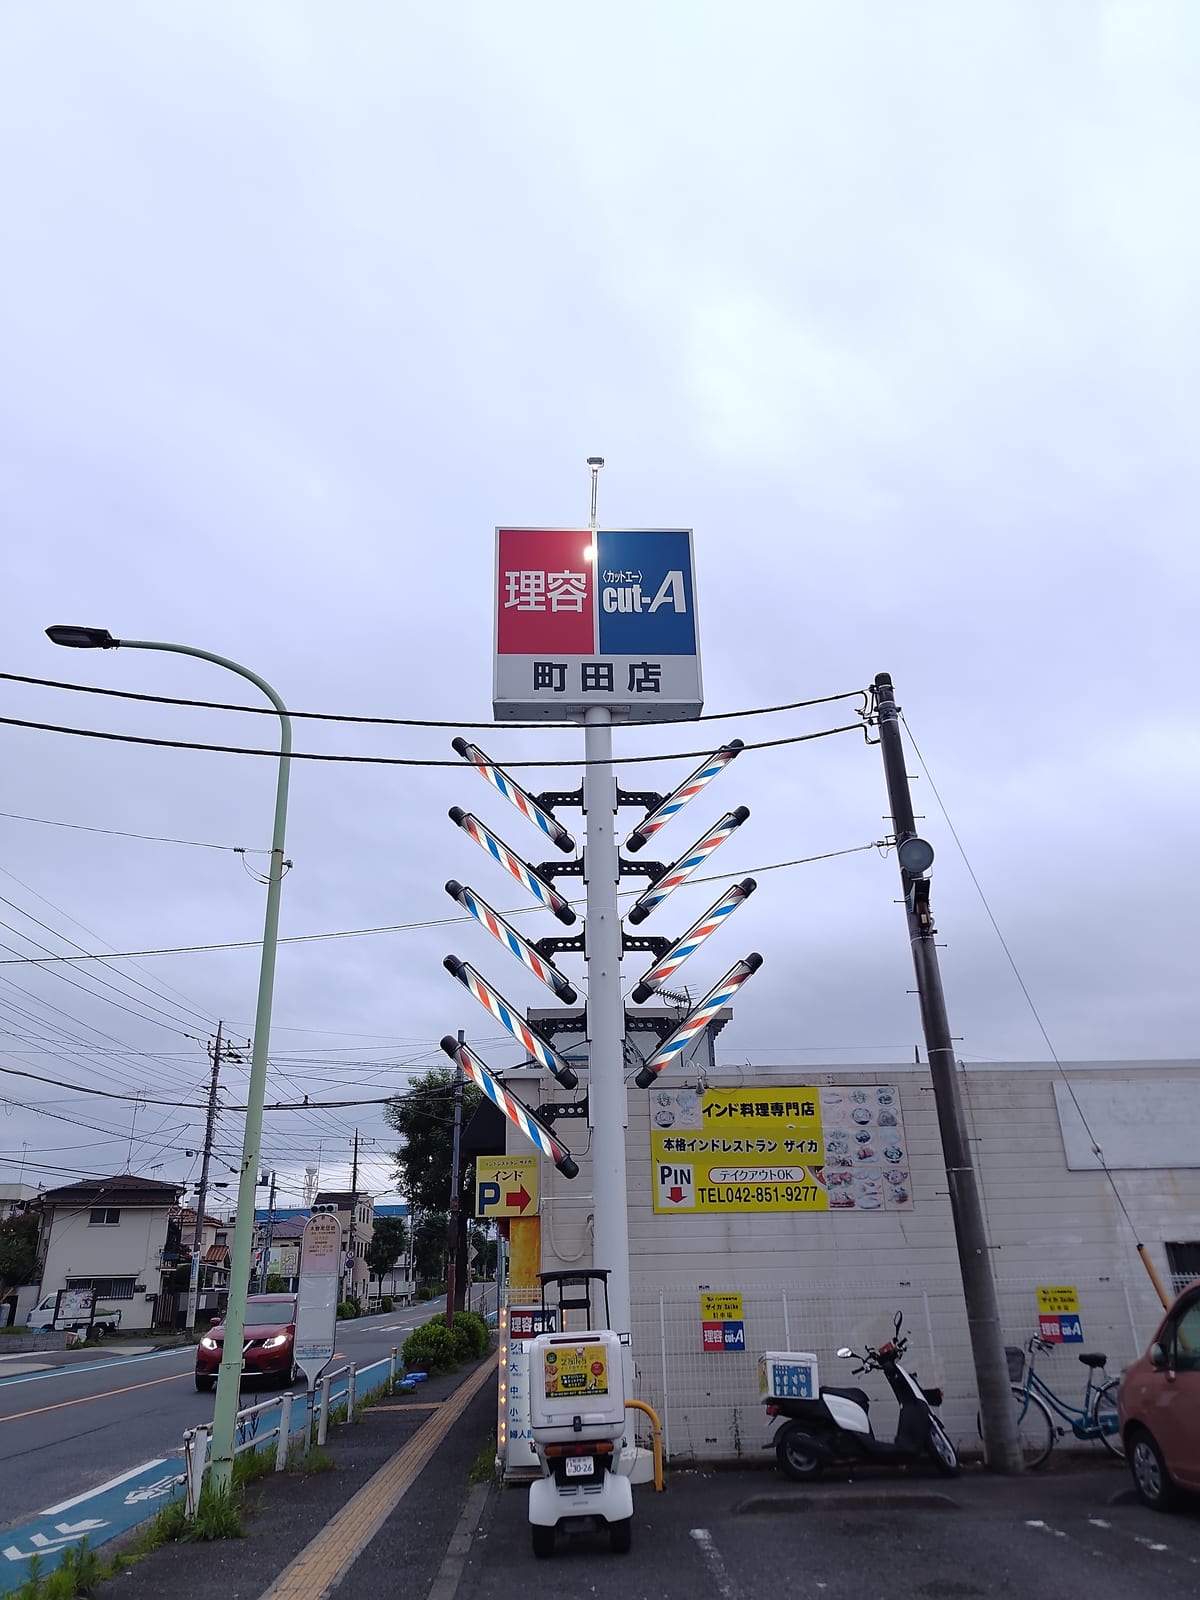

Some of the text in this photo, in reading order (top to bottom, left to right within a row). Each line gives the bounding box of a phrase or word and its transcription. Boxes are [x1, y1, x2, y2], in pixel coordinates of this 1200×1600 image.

[504, 569, 588, 613] 理容
[602, 570, 687, 613] cut-A
[533, 661, 662, 692] 町田店
[702, 1101, 815, 1118] インド料理専門店
[663, 1138, 819, 1153] 本格インドレストラン ザイカ
[491, 1170, 524, 1182] インド
[660, 1165, 692, 1185] PIN
[719, 1169, 794, 1181] テイクアウトOK
[478, 1182, 500, 1215] P
[698, 1186, 818, 1203] TEL042-851-9277
[511, 1316, 533, 1333] 理容
